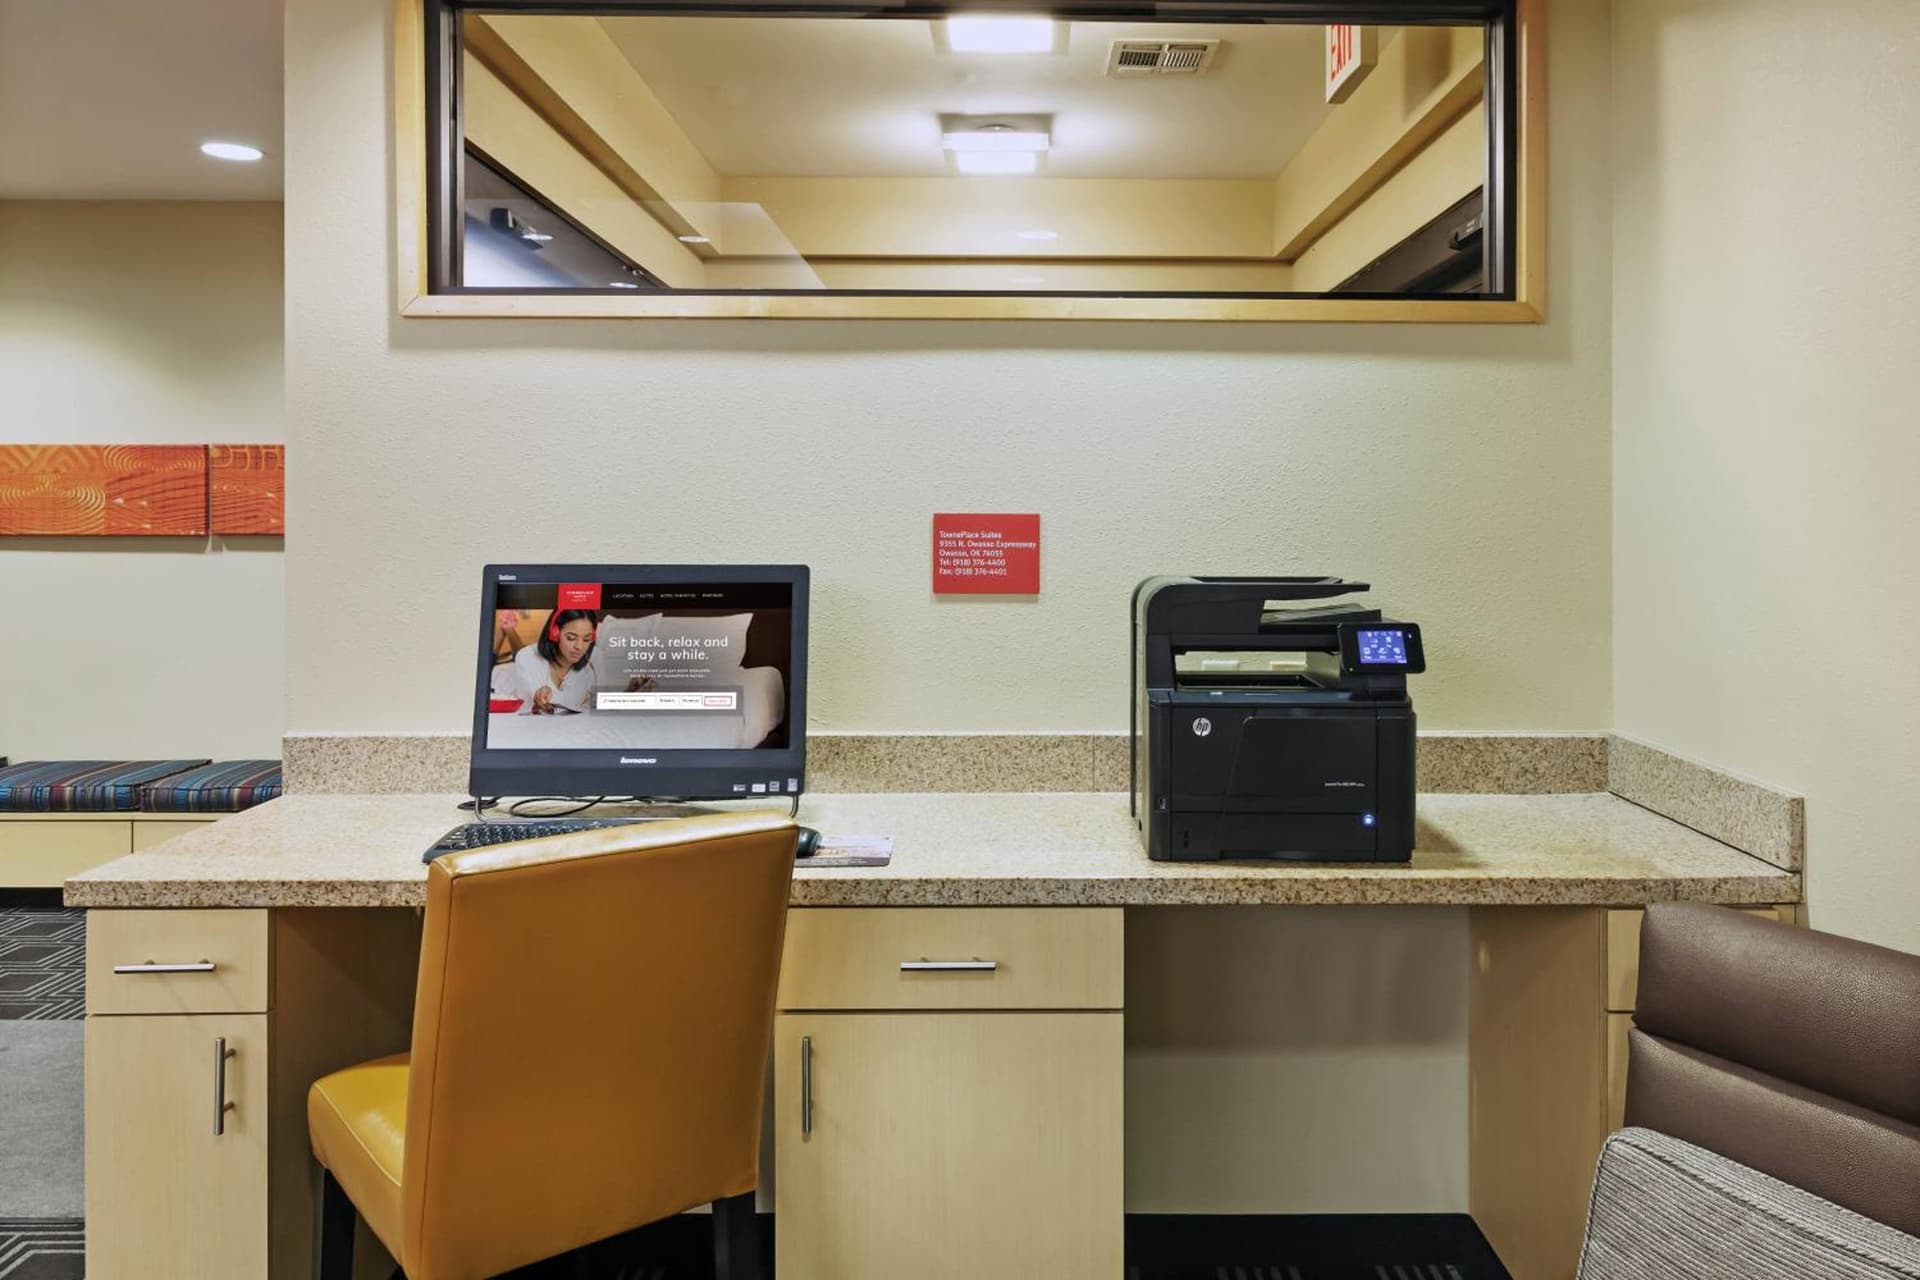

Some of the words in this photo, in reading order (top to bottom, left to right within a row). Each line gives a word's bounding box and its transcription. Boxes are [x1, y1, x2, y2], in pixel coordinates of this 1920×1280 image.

[980, 531, 1002, 539] Suites
[967, 540, 995, 548] Owasso
[996, 541, 1037, 550] Expressway
[952, 559, 971, 567] (918)
[939, 568, 953, 576] Fax:
[954, 568, 973, 576] (918)
[609, 636, 627, 648] Sit
[630, 636, 664, 649] back,
[668, 636, 701, 648] relax
[704, 636, 728, 648] and
[627, 650, 655, 663] stay
[658, 652, 667, 661] a
[671, 649, 709, 661] while.
[1195, 717, 1210, 736] hp
[620, 756, 657, 764] lenovo
